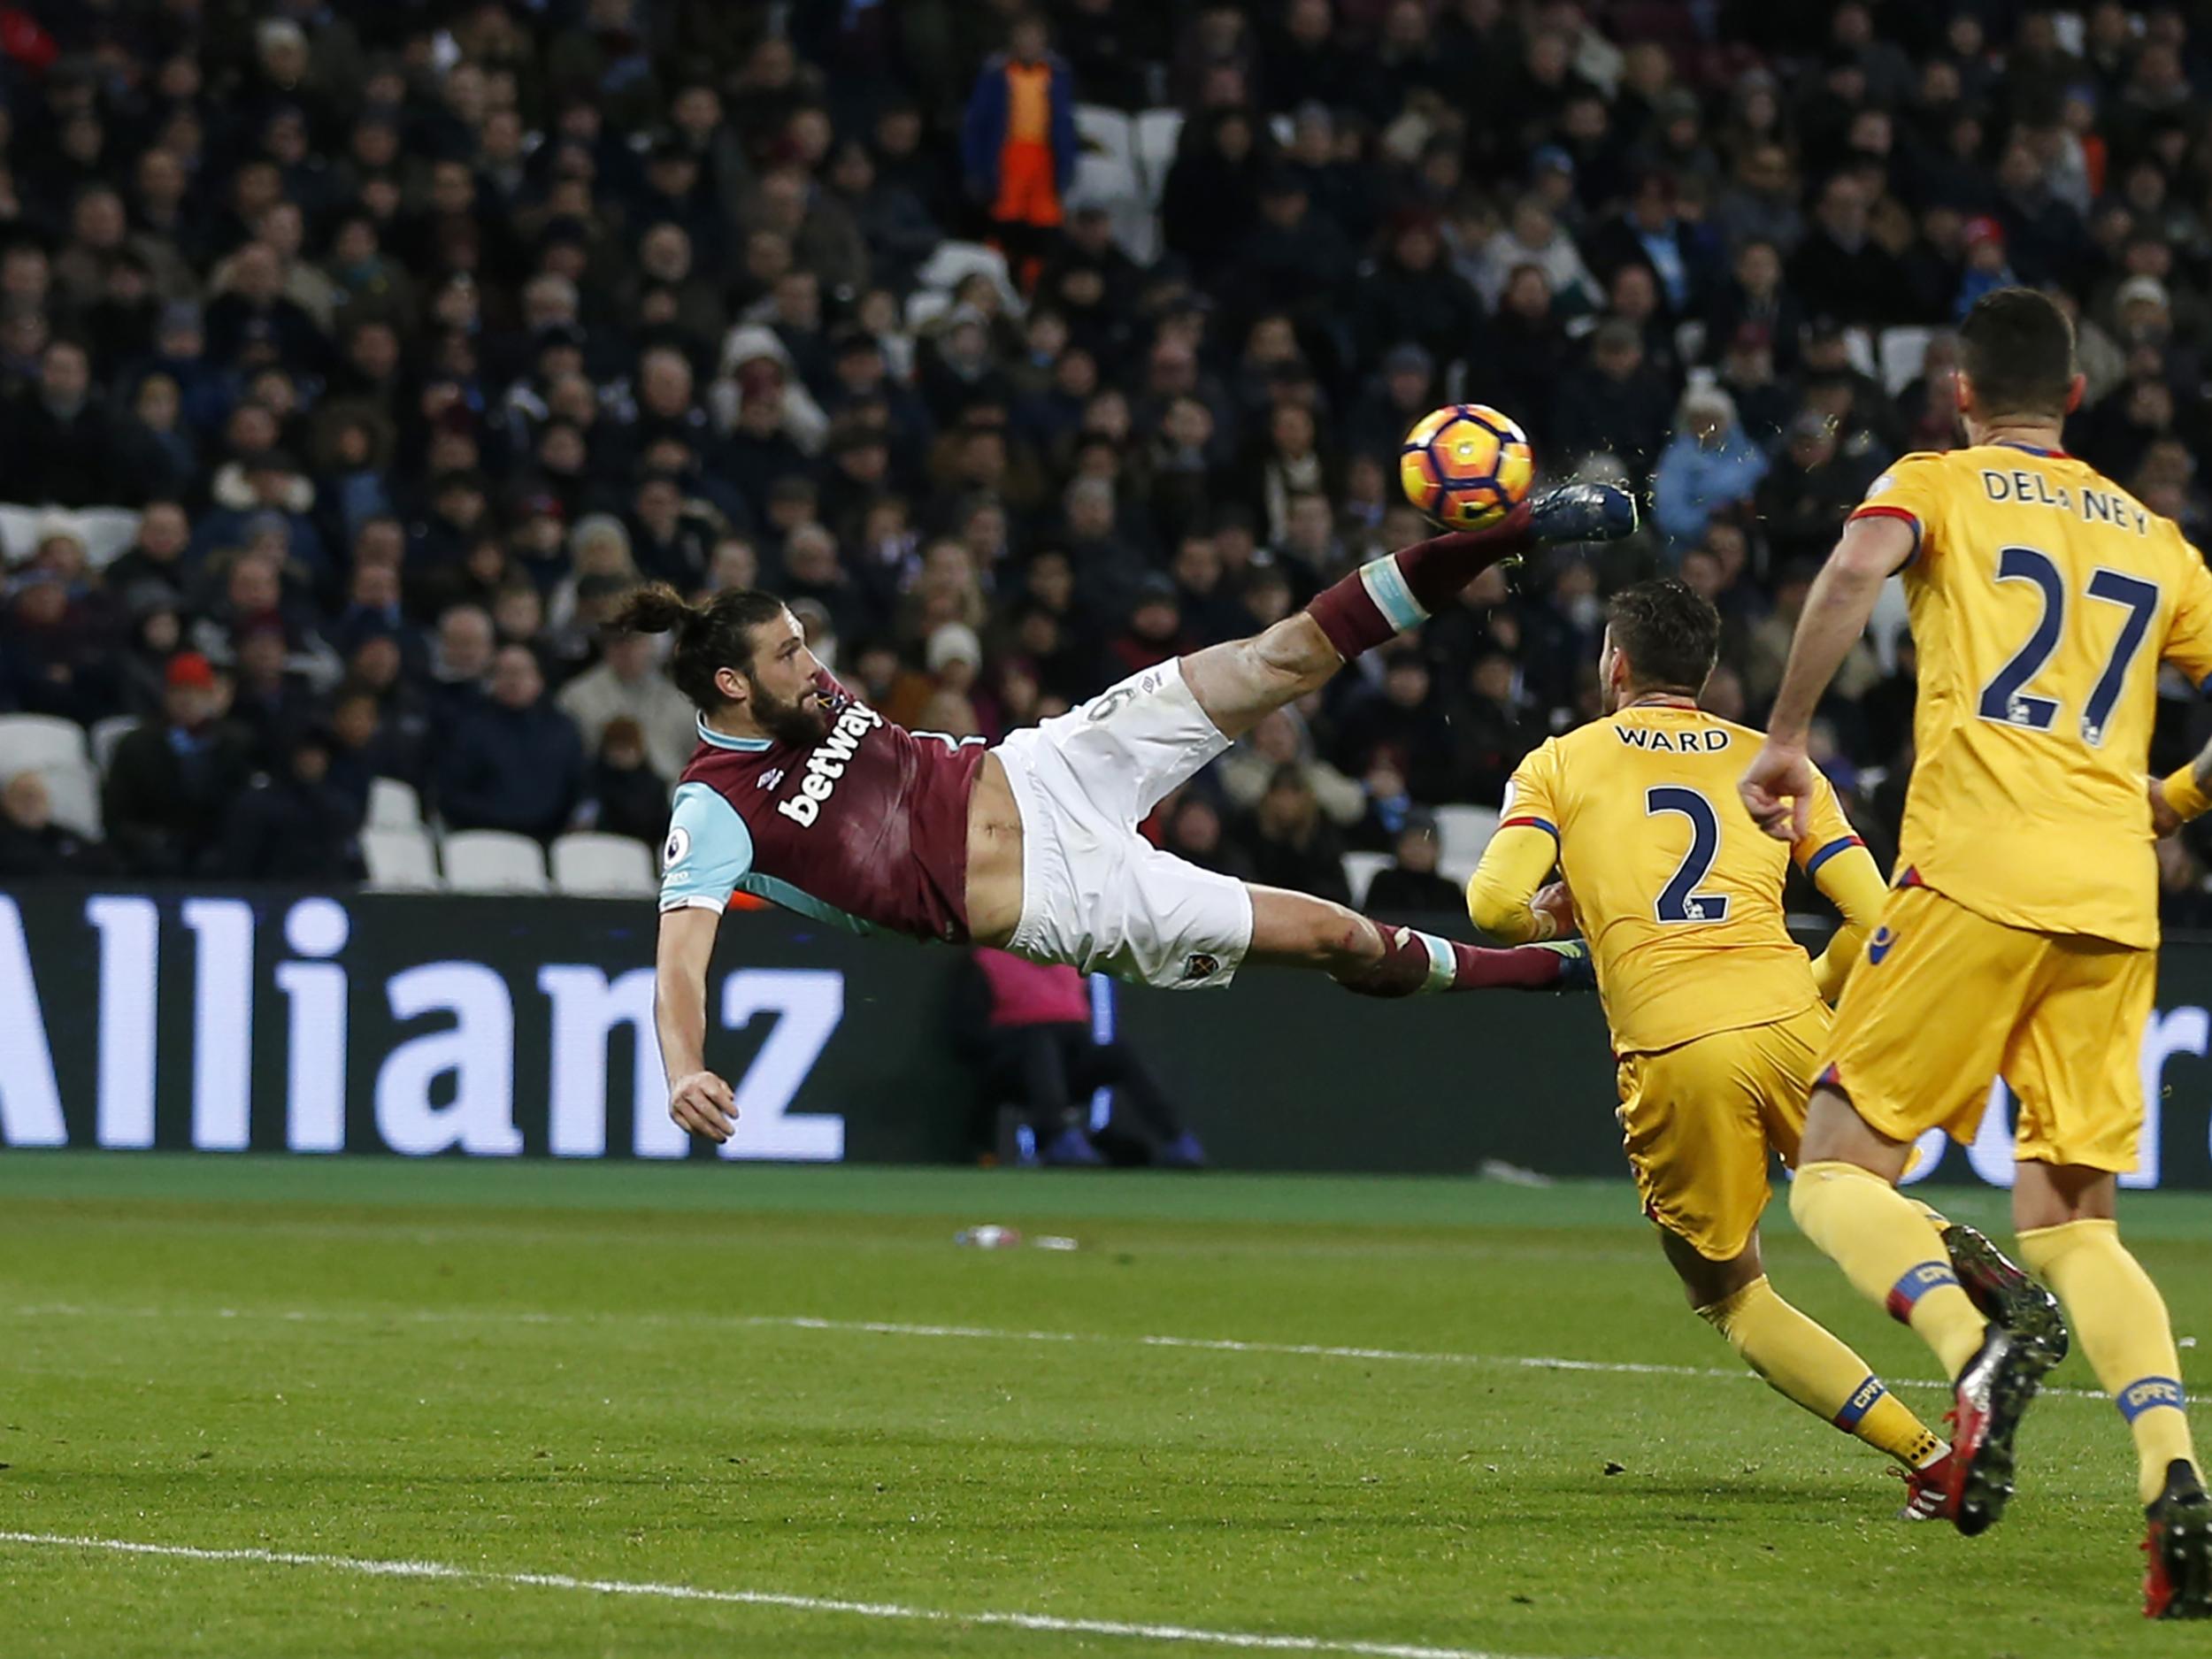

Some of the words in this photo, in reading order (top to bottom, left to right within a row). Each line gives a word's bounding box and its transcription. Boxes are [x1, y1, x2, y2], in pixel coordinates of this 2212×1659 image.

[1976, 545, 2159, 749] 27
[778, 700, 883, 828] betway
[1612, 724, 1732, 754] WARD
[1644, 783, 1732, 925] 2
